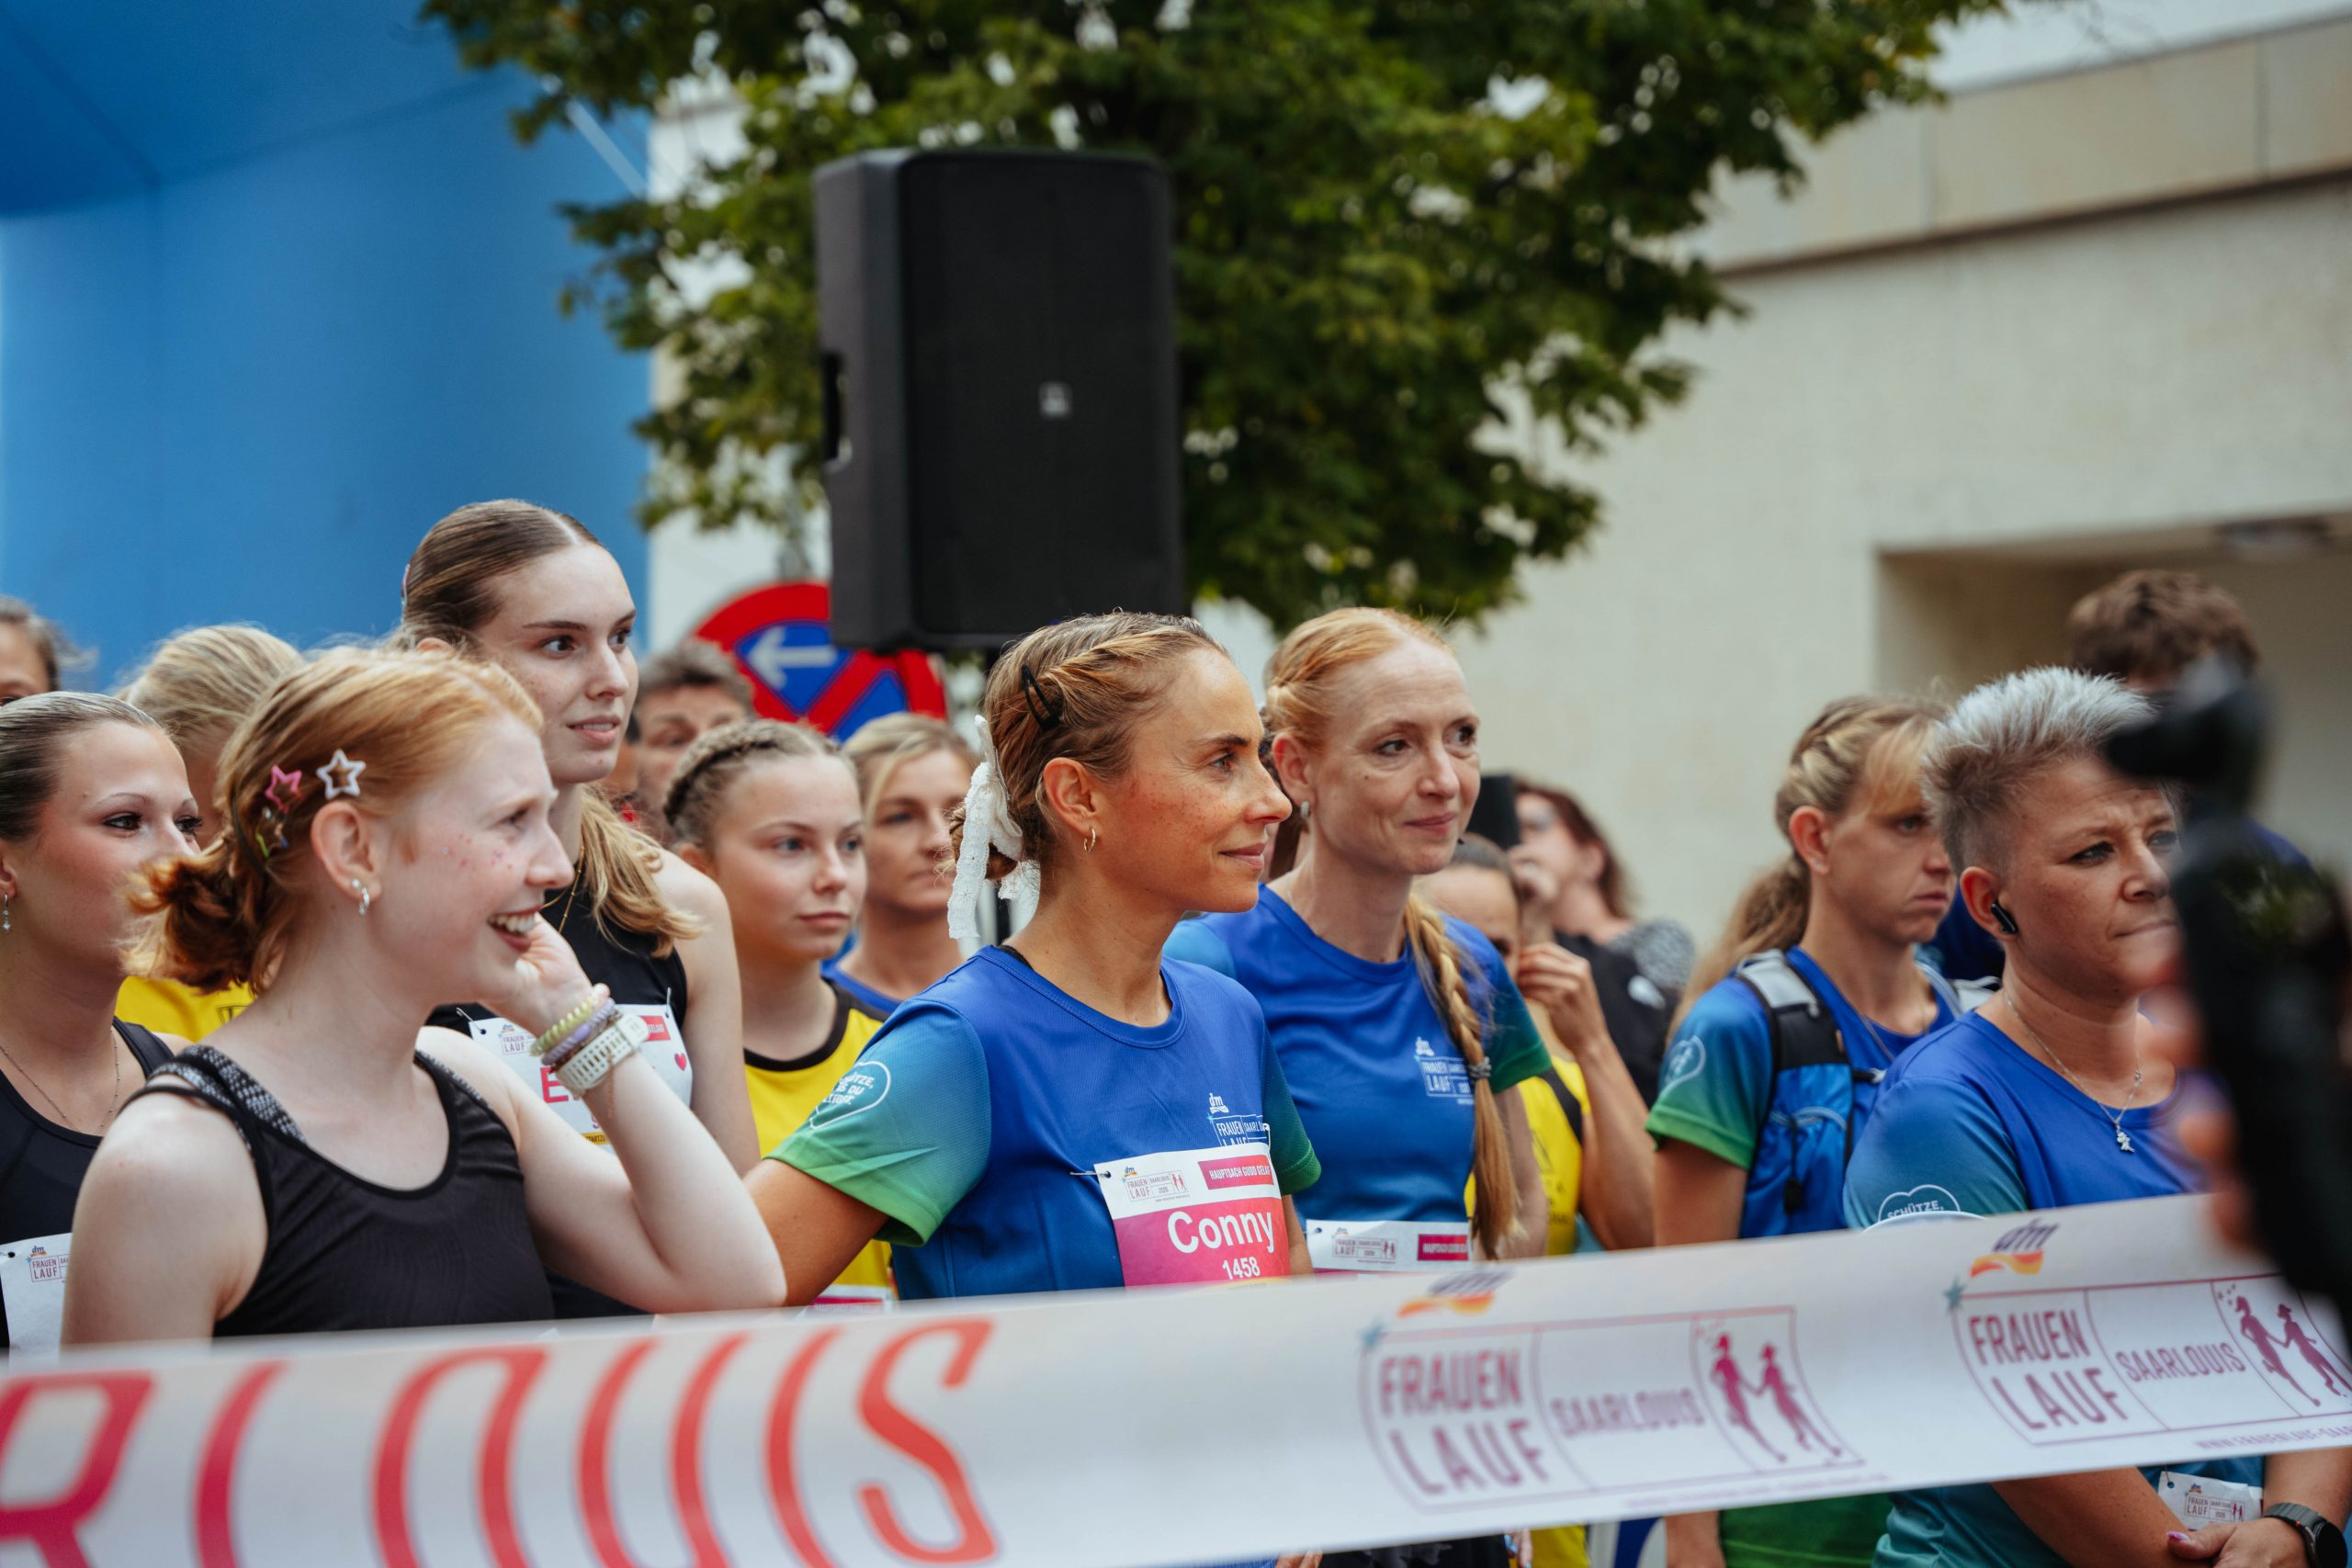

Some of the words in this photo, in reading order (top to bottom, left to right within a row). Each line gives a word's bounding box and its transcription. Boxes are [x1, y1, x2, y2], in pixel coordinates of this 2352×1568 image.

[504, 1043, 525, 1052] LAUF
[1216, 1121, 1245, 1136] FRAUEN
[1209, 1166, 1243, 1179] HAUPTSACH
[1127, 1178, 1148, 1189] FRAUEN
[1129, 1186, 1151, 1199] LAUF
[1167, 1211, 1275, 1254] Conny
[32, 1245, 44, 1254] dm
[32, 1258, 57, 1269] FRAUEN
[1222, 1256, 1261, 1280] 1458
[33, 1267, 58, 1280] LAUF
[1967, 1309, 2091, 1366] FRAUEN
[2115, 1343, 2247, 1383] SAARLOUIS
[1380, 1348, 1522, 1418] FRAUEN
[1549, 1386, 1706, 1438] SAARLOUIS
[1991, 1368, 2130, 1430] LAUF
[1390, 1419, 1549, 1496] LAUF
[2187, 1505, 2209, 1517] LAUF
